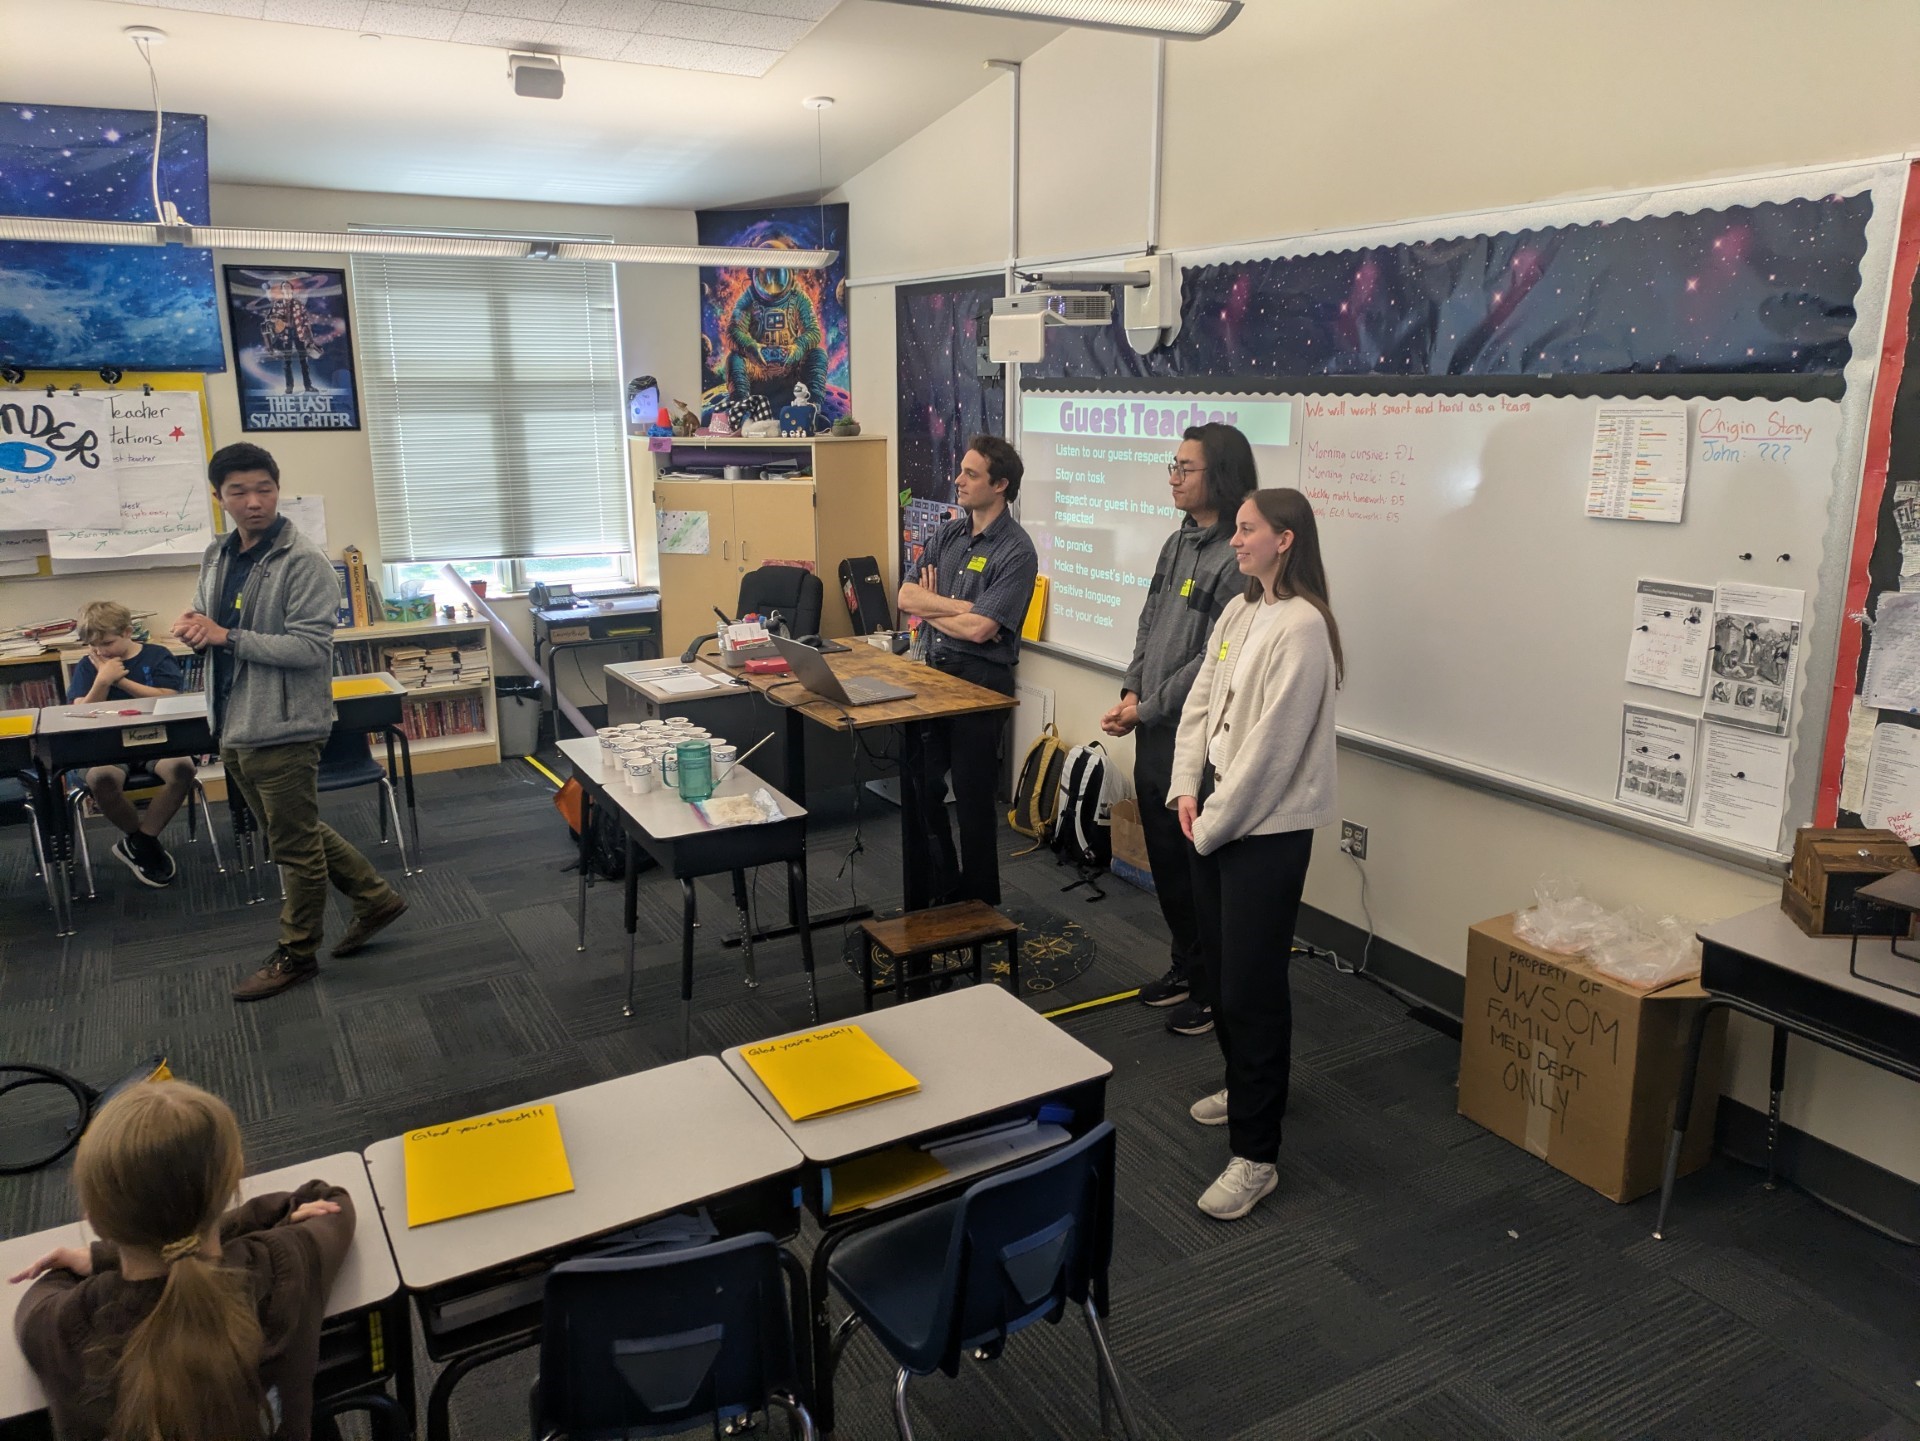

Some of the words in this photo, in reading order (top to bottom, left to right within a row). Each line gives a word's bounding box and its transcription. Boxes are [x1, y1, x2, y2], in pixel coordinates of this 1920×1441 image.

[104, 393, 171, 419] Teacher
[265, 396, 296, 413] THE
[300, 396, 333, 412] LAST
[1060, 400, 1127, 434] Guest
[1305, 401, 1324, 418] We
[1327, 401, 1346, 417] will
[1350, 402, 1377, 417] work
[1382, 400, 1413, 416] smart
[1415, 402, 1434, 415] and
[1438, 400, 1464, 413] hard
[1469, 402, 1483, 412] as
[1487, 404, 1496, 412] a
[1501, 397, 1531, 412] team
[250, 412, 352, 428] STARFIGHTER
[1768, 411, 1812, 443] Story
[1055, 443, 1081, 457] Listen
[1082, 447, 1092, 457] to
[1092, 450, 1106, 460] our
[1108, 449, 1133, 463] guest
[1307, 440, 1347, 468] Morning
[1055, 467, 1074, 483] Stay
[1075, 472, 1086, 482] on
[1087, 471, 1106, 484] task
[1308, 466, 1343, 484] Morning
[1055, 491, 1088, 507] Respect
[1089, 497, 1103, 508] our
[1104, 498, 1129, 512] guest
[1130, 500, 1139, 512] in
[1140, 501, 1155, 515] the
[1156, 507, 1177, 520] way
[1304, 486, 1330, 505] Weekly
[1332, 491, 1351, 502] math
[1054, 510, 1094, 525] respected
[1054, 535, 1066, 549] No
[1066, 538, 1093, 553] pranks
[1053, 559, 1074, 574] Make
[1075, 563, 1089, 577] the
[1090, 567, 1121, 582] guest's
[1121, 572, 1135, 586] job
[1053, 581, 1084, 598] Positive
[1085, 587, 1121, 607] language
[1053, 603, 1065, 616] Sit
[1065, 606, 1075, 618] at
[1075, 608, 1093, 621] your
[1093, 613, 1114, 628] desk
[1509, 951, 1567, 984] PROPERTY
[1579, 978, 1603, 997] OF
[1492, 956, 1619, 1066] UWSOM
[1487, 998, 1576, 1059] FAMILY
[1490, 1025, 1531, 1060] MED
[1537, 1051, 1588, 1090] DEPT
[1503, 1061, 1570, 1135] ONLY
